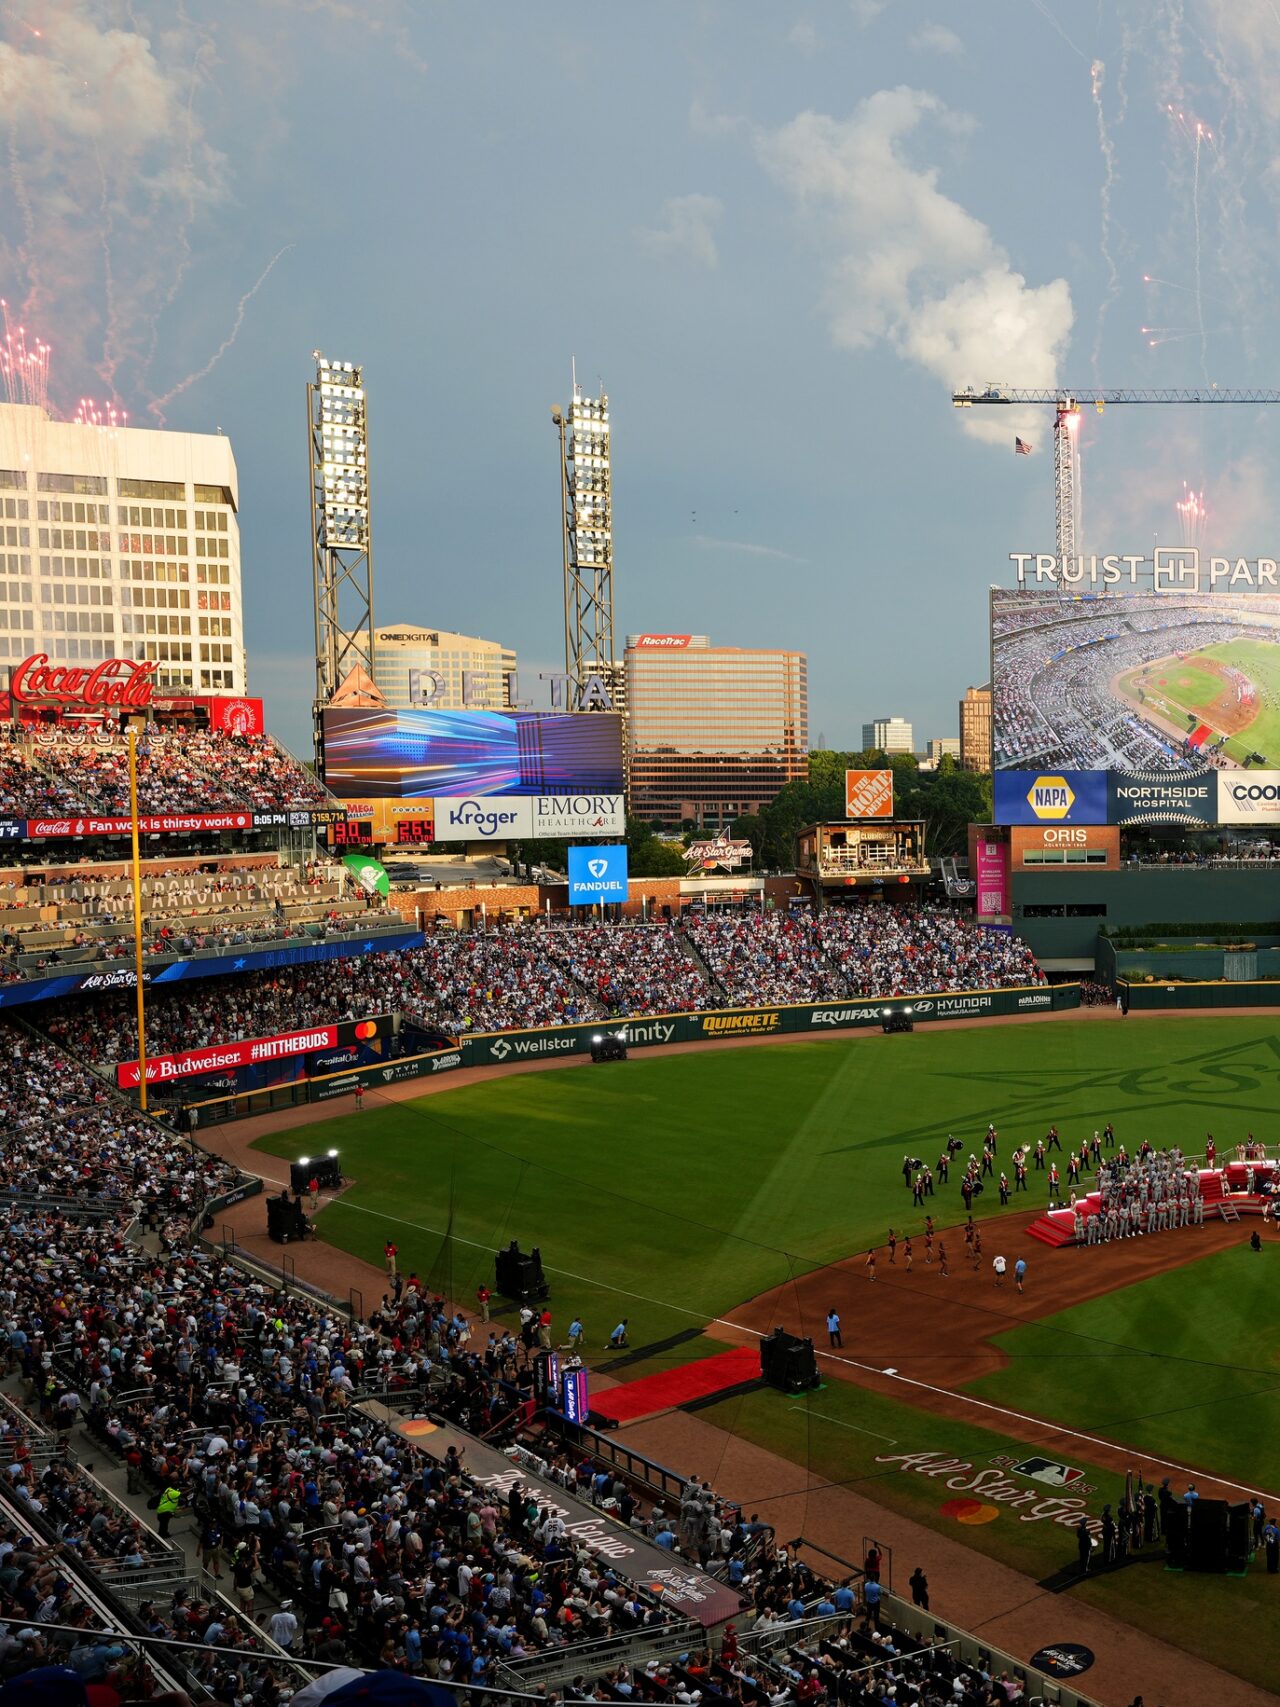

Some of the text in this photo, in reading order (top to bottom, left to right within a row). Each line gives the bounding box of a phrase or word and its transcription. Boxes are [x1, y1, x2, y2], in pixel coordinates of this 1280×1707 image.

[1009, 553, 1145, 583] TRUIST
[380, 633, 438, 642] ONEDIGITAL
[642, 637, 685, 646] RaceTrac
[409, 668, 613, 711] DELTA
[852, 776, 871, 793] THE
[848, 770, 892, 817] HOME
[1035, 789, 1067, 807] NAPA
[1117, 787, 1208, 798] NORTHSIDE
[347, 804, 374, 812] MEGA
[537, 797, 619, 815] EMORY
[865, 787, 892, 817] DEPOT
[1133, 800, 1191, 808] HOSPITAL
[89, 821, 113, 831] Fan
[150, 818, 161, 829] is
[163, 816, 202, 830] thirsty
[204, 816, 234, 828] work
[254, 815, 272, 825] 8:05
[275, 814, 287, 824] PM
[312, 812, 344, 823] $159,714
[450, 801, 518, 835] Kroger
[538, 816, 616, 827] HEALTHCARE
[336, 823, 358, 837] 90
[400, 821, 433, 835] 264
[1043, 829, 1087, 842] ORIS
[682, 846, 753, 859] All Star Game
[574, 881, 623, 892] FANDUEL
[80, 973, 125, 989] All Star
[937, 997, 992, 1010] HYUNDAI
[811, 1008, 880, 1024] EQUIFAX
[937, 1008, 980, 1016] HyundaiUSA.com
[703, 1013, 779, 1030] QUIKRETE
[251, 1032, 329, 1059] #HITTHEBUDS
[515, 1036, 576, 1052] Wellstar
[160, 1052, 239, 1077] Budweiser
[395, 1063, 419, 1072] TYM
[874, 1451, 1039, 1509] All Star
[564, 1518, 635, 1559] League
